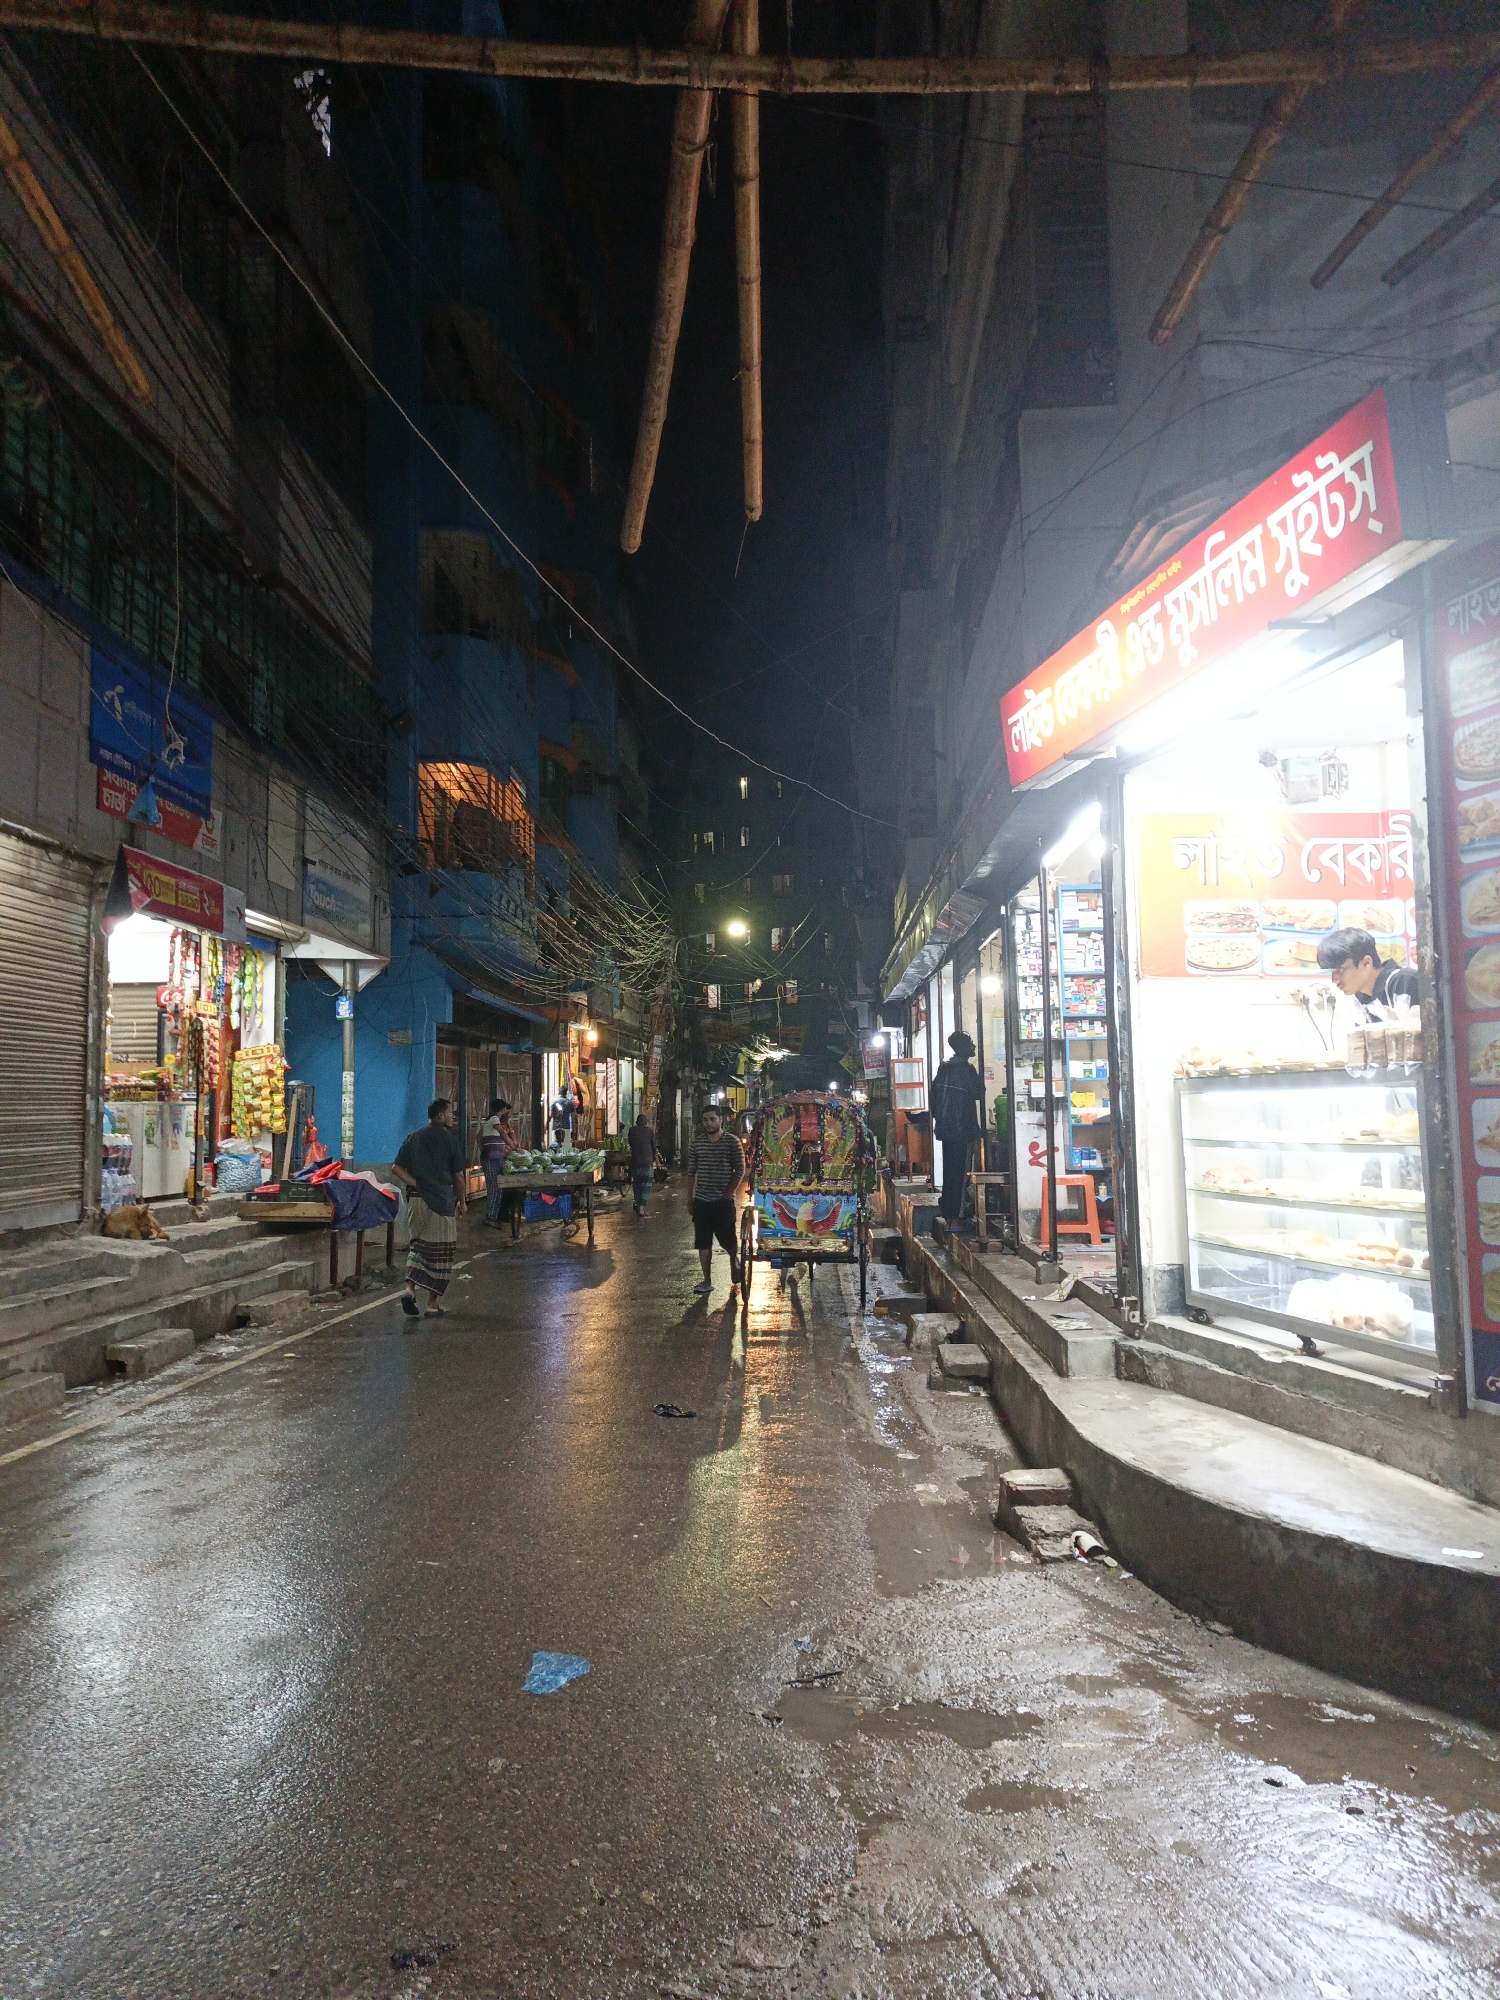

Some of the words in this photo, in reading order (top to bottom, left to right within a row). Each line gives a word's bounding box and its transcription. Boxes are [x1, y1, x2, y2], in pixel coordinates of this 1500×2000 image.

[1008, 686, 1055, 753] লাইভ
[1056, 619, 1123, 726] বেকারী
[1124, 601, 1164, 677] এন্ড
[1164, 530, 1267, 667] মুসলিম
[1172, 819, 1287, 888] লাইভ
